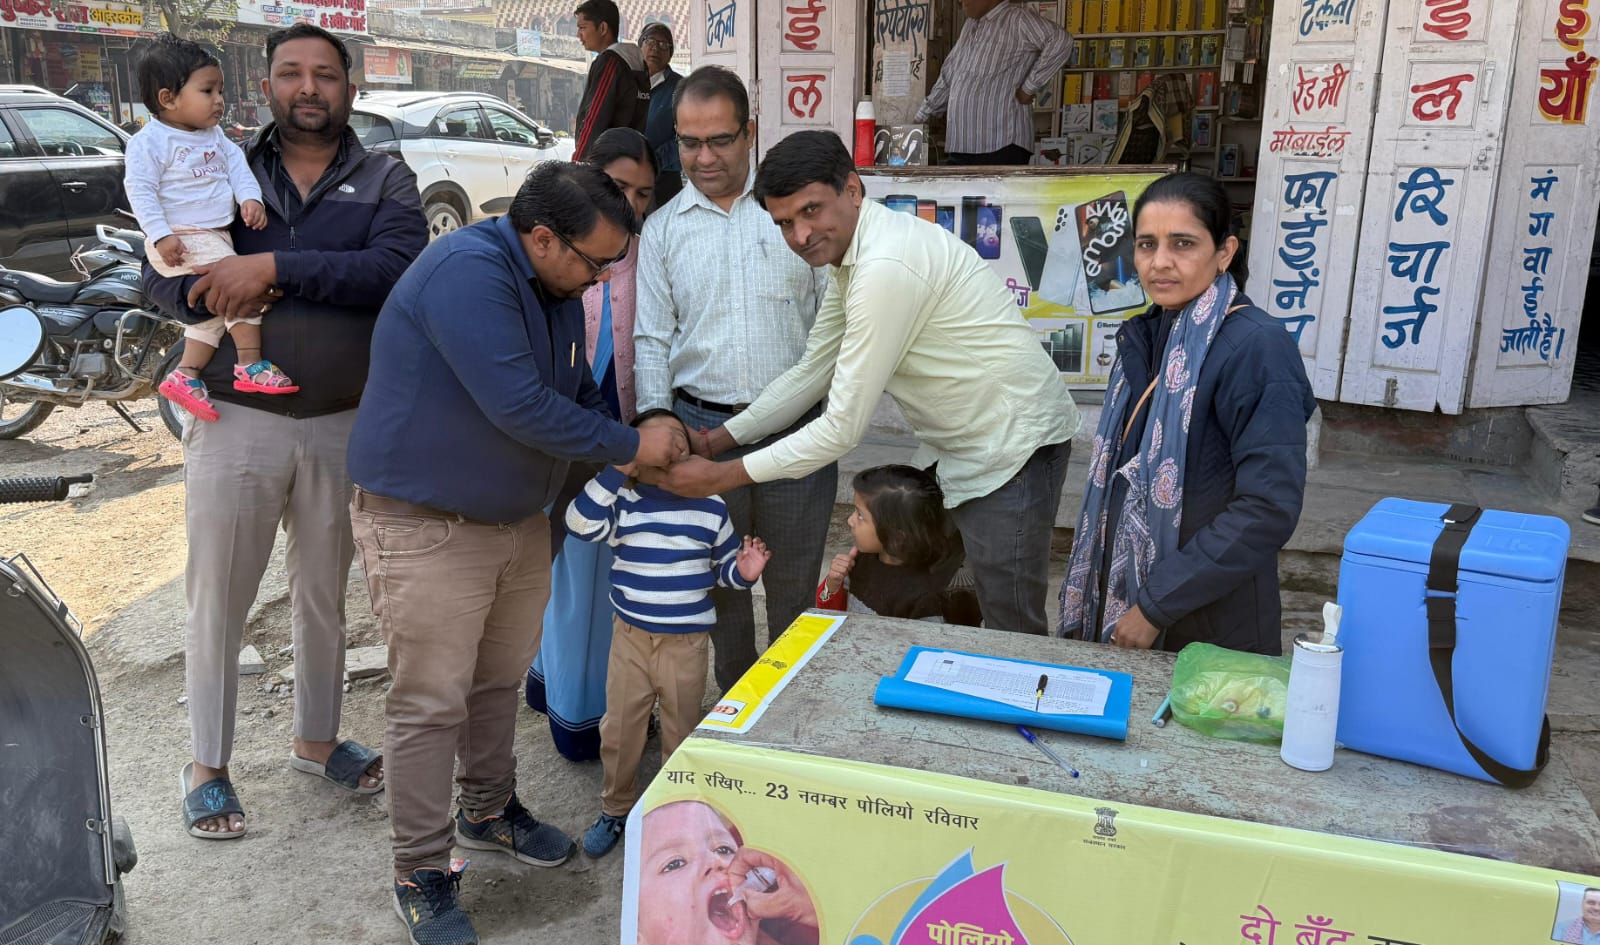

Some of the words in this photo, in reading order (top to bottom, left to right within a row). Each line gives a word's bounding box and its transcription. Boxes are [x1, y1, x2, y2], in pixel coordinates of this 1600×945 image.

[665, 768, 696, 786] याद
[765, 782, 789, 801] 23
[798, 790, 848, 810] नवम्बर
[857, 796, 914, 820] पोलियो
[923, 808, 980, 831] रविवार
